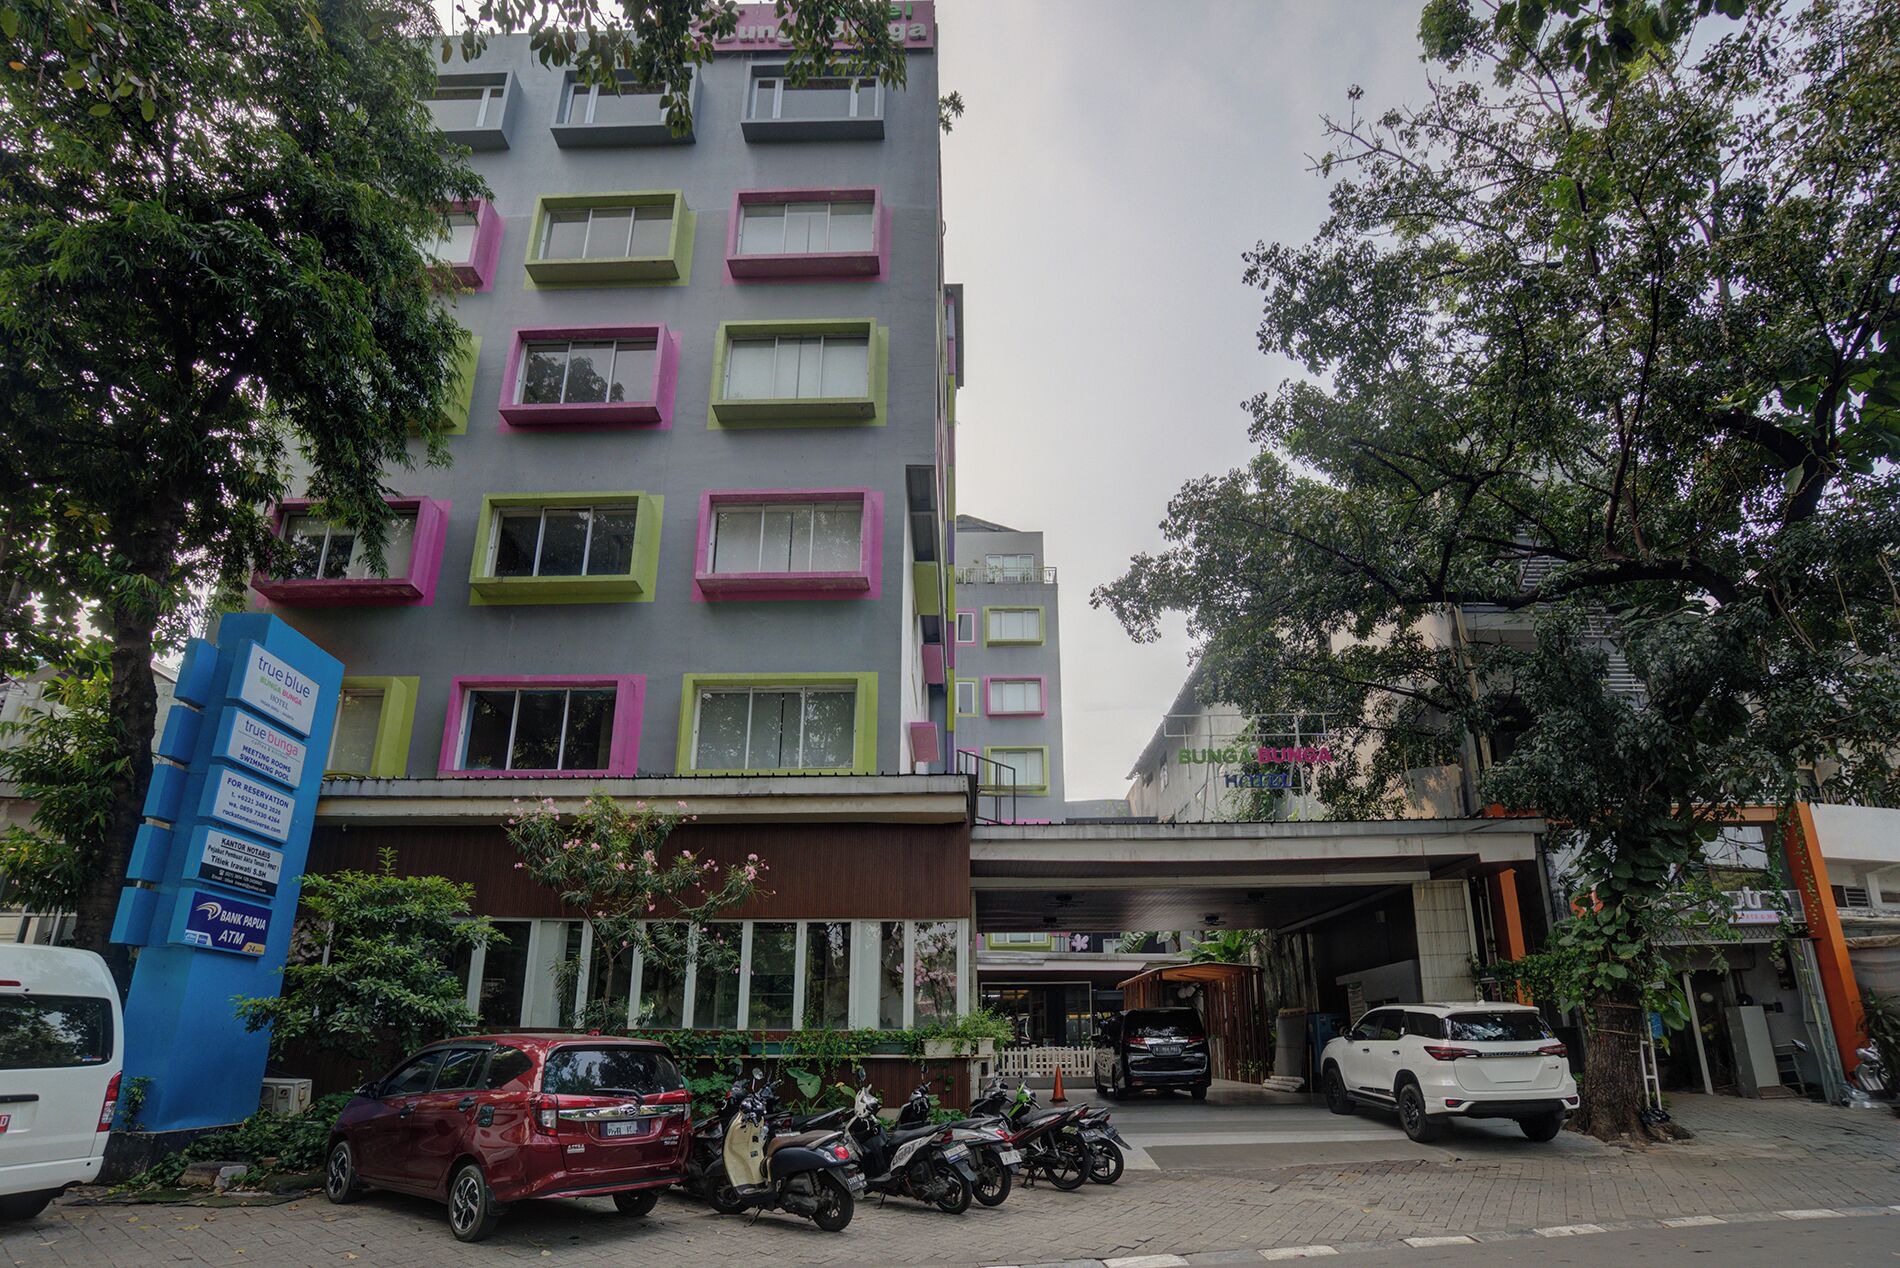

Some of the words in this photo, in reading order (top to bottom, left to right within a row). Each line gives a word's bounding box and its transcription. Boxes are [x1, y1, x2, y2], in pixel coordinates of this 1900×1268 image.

[258, 656, 283, 681] true
[285, 672, 310, 698] blue
[270, 694, 288, 710] HOTEL
[245, 720, 266, 739] true
[267, 731, 299, 756] bunga
[240, 753, 274, 774] SWIMMING
[274, 769, 289, 781] POOL
[243, 745, 270, 763] MEETING
[271, 758, 291, 773] ROOMS
[1178, 748, 1253, 764] BUNGA
[1258, 747, 1332, 763] BUNGA
[227, 777, 242, 789] FOR
[243, 784, 289, 809] RESERVATION
[221, 838, 246, 851] KANTOR
[246, 845, 271, 859] NOTARIS
[220, 910, 243, 925] BANK
[243, 915, 266, 930] PAPUA
[218, 929, 245, 945] ATM
